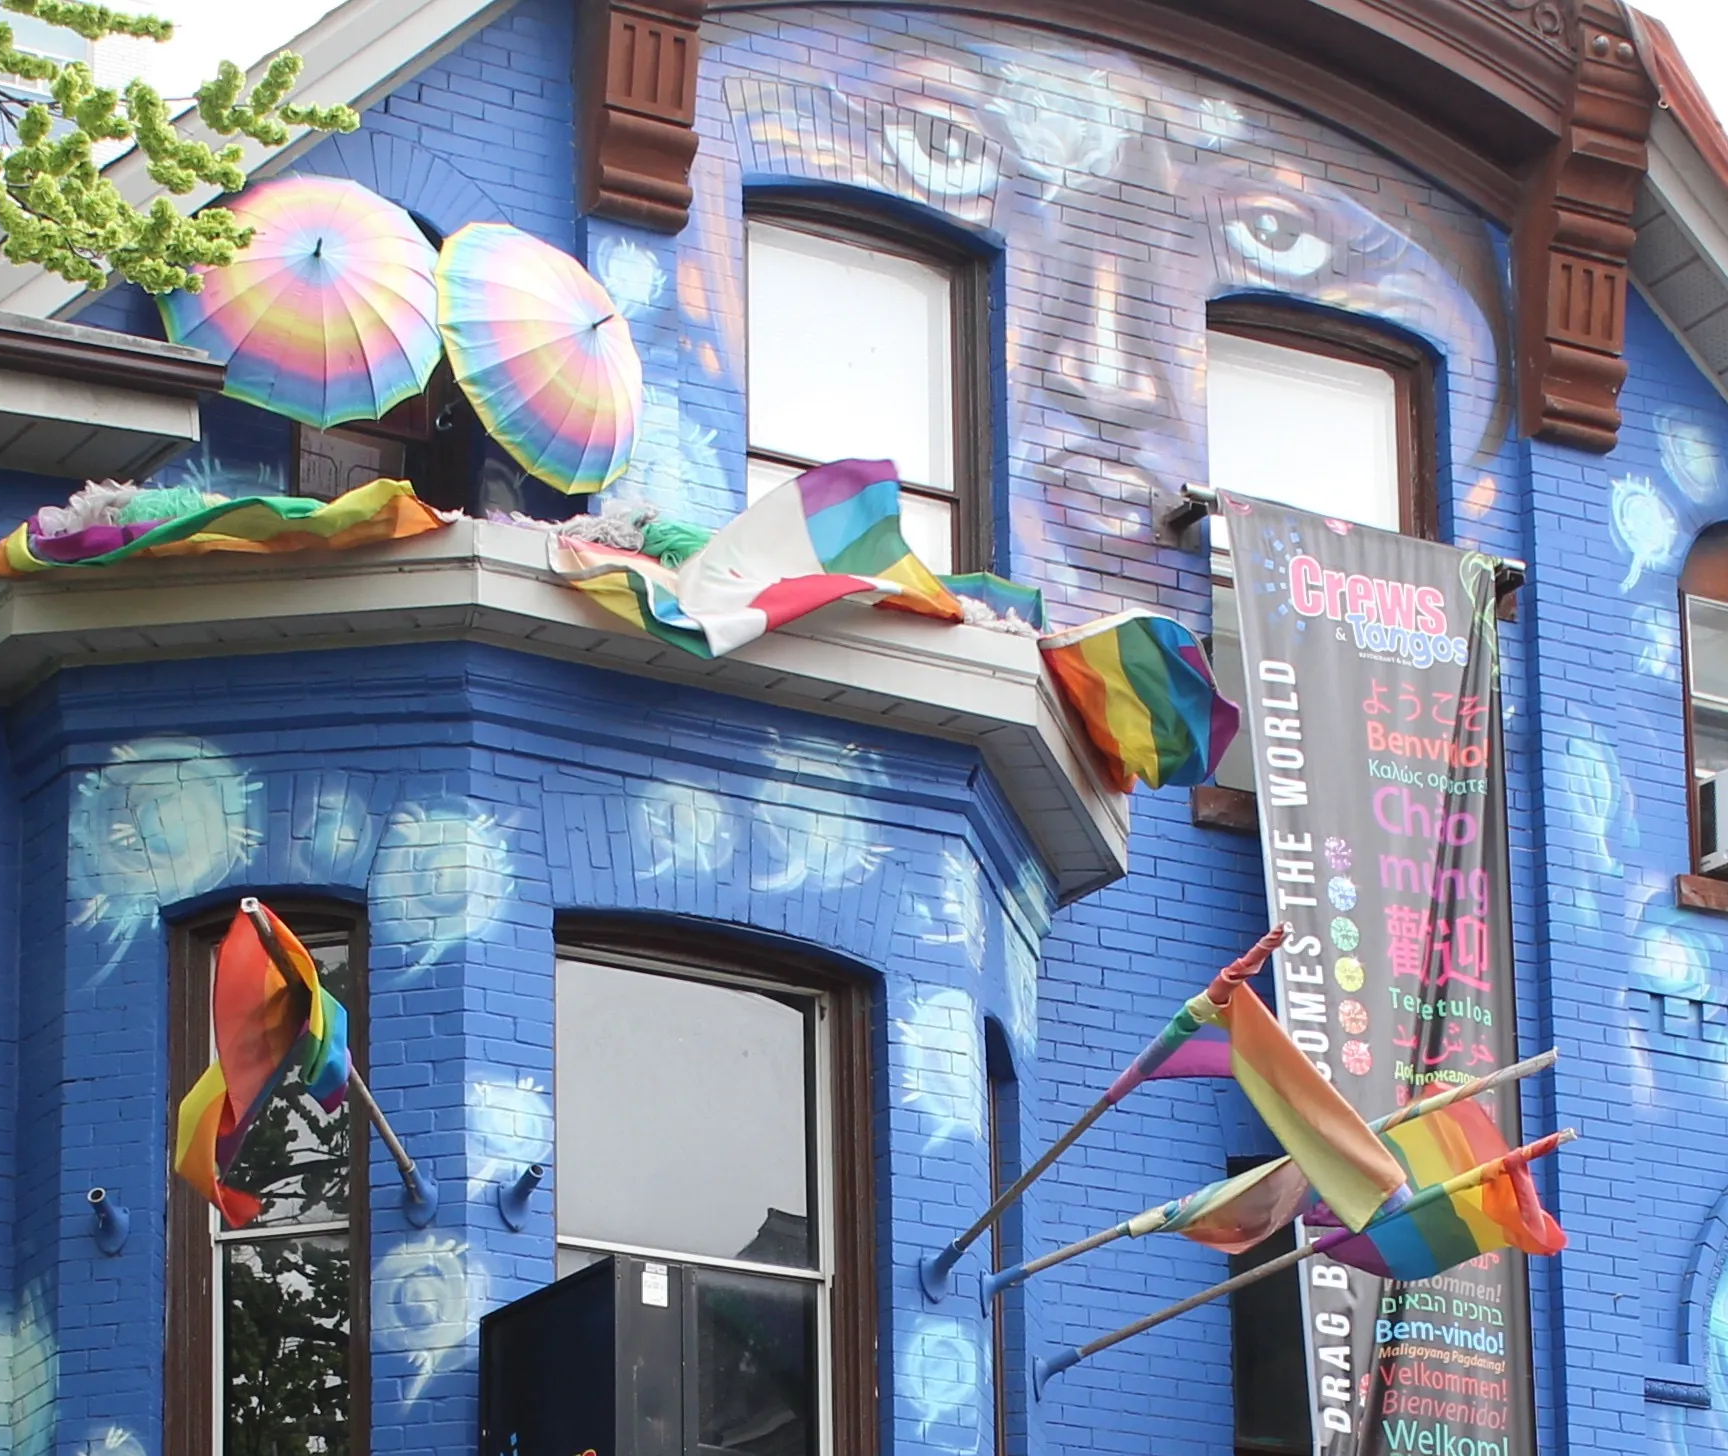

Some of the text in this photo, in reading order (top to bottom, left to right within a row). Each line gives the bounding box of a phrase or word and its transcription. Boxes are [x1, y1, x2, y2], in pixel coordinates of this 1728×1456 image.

[1289, 554, 1448, 636] Crews
[1335, 626, 1347, 642] &
[1345, 613, 1469, 669] Tangos
[1362, 679, 1490, 731] ようこそ
[1258, 659, 1309, 806] WORLD
[1274, 831, 1318, 910] THE
[1376, 1319, 1505, 1356] Bem-vindo!
[1378, 1344, 1506, 1374] Maligayang Pagdating!
[1314, 1311, 1352, 1434] DRAG
[1380, 1362, 1508, 1402] Velkommen!
[1382, 1391, 1508, 1430] Bienvenido!
